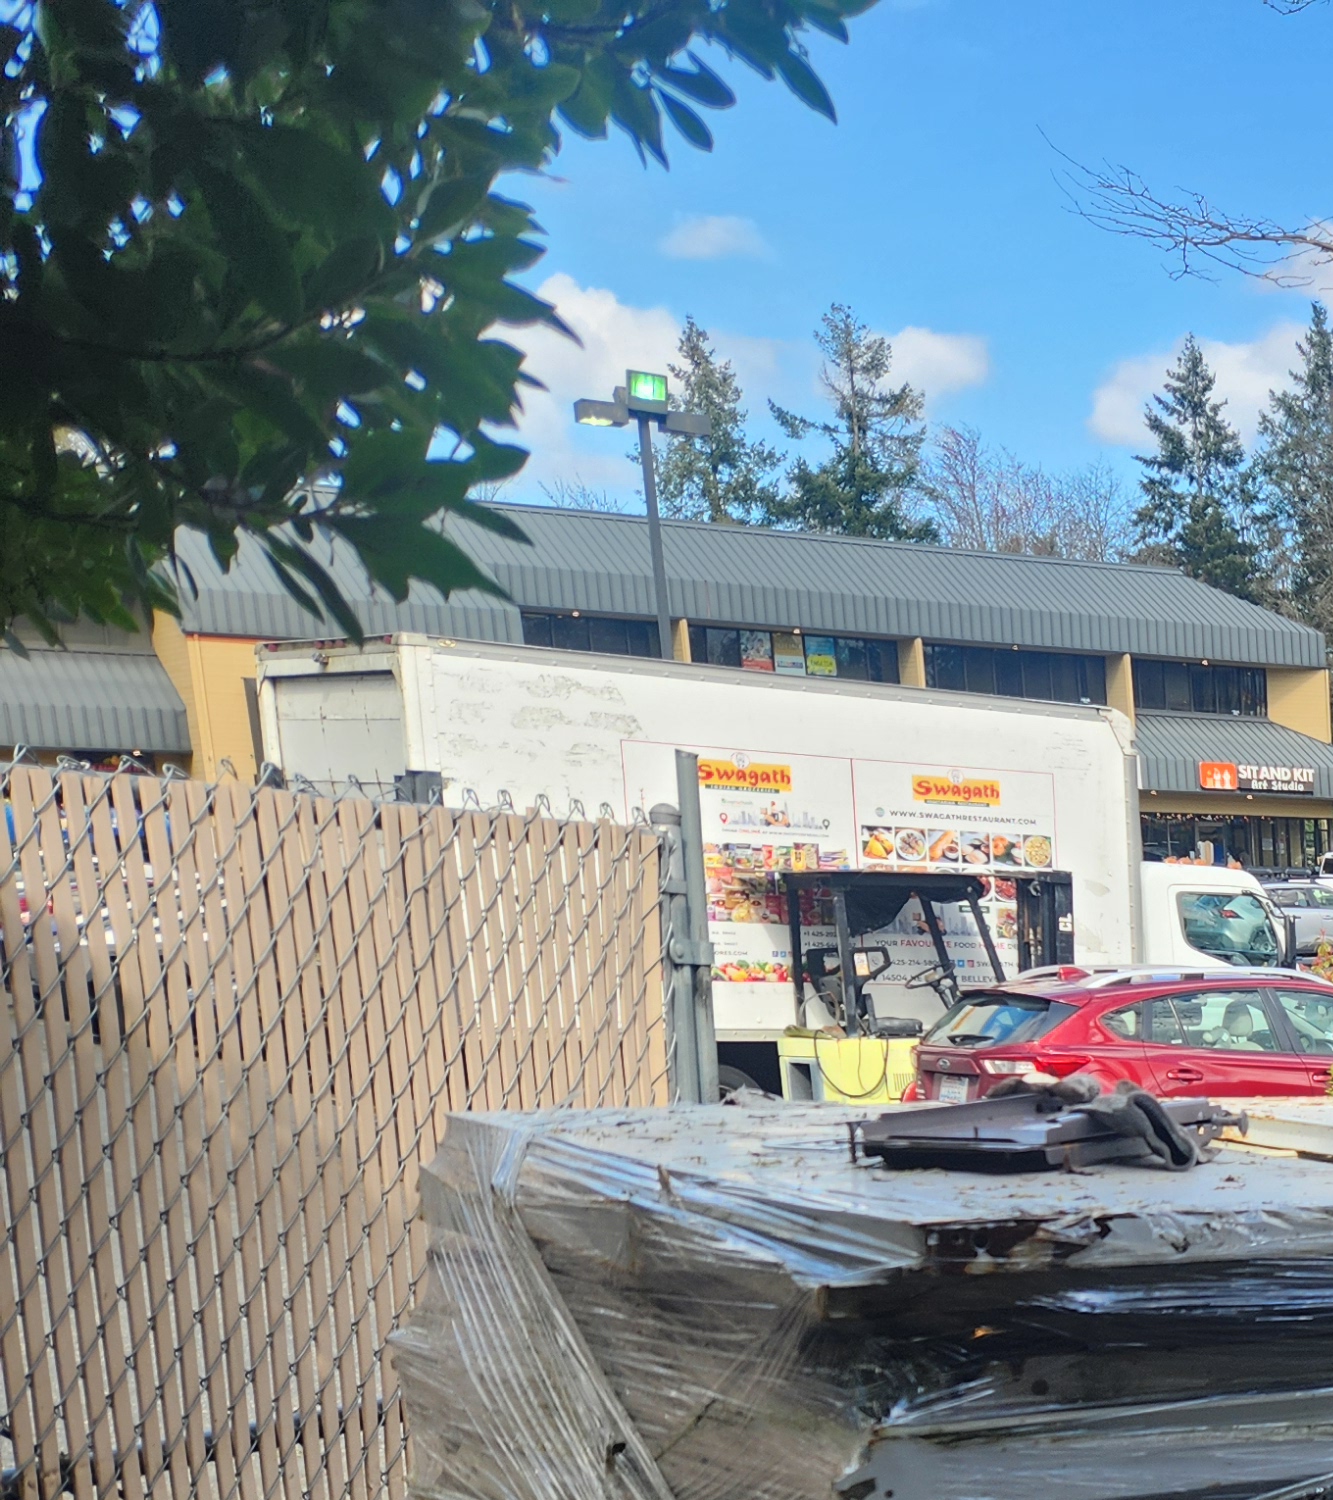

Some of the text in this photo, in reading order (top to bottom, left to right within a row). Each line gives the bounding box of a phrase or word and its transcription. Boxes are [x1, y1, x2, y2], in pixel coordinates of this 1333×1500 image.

[698, 764, 791, 786] Swagath
[1238, 765, 1315, 783] SIT AND KIT
[913, 780, 999, 801] Swagath
[1251, 780, 1304, 792] Art Studio
[875, 939, 898, 947] YOUR
[900, 939, 952, 948] FAVOUE
